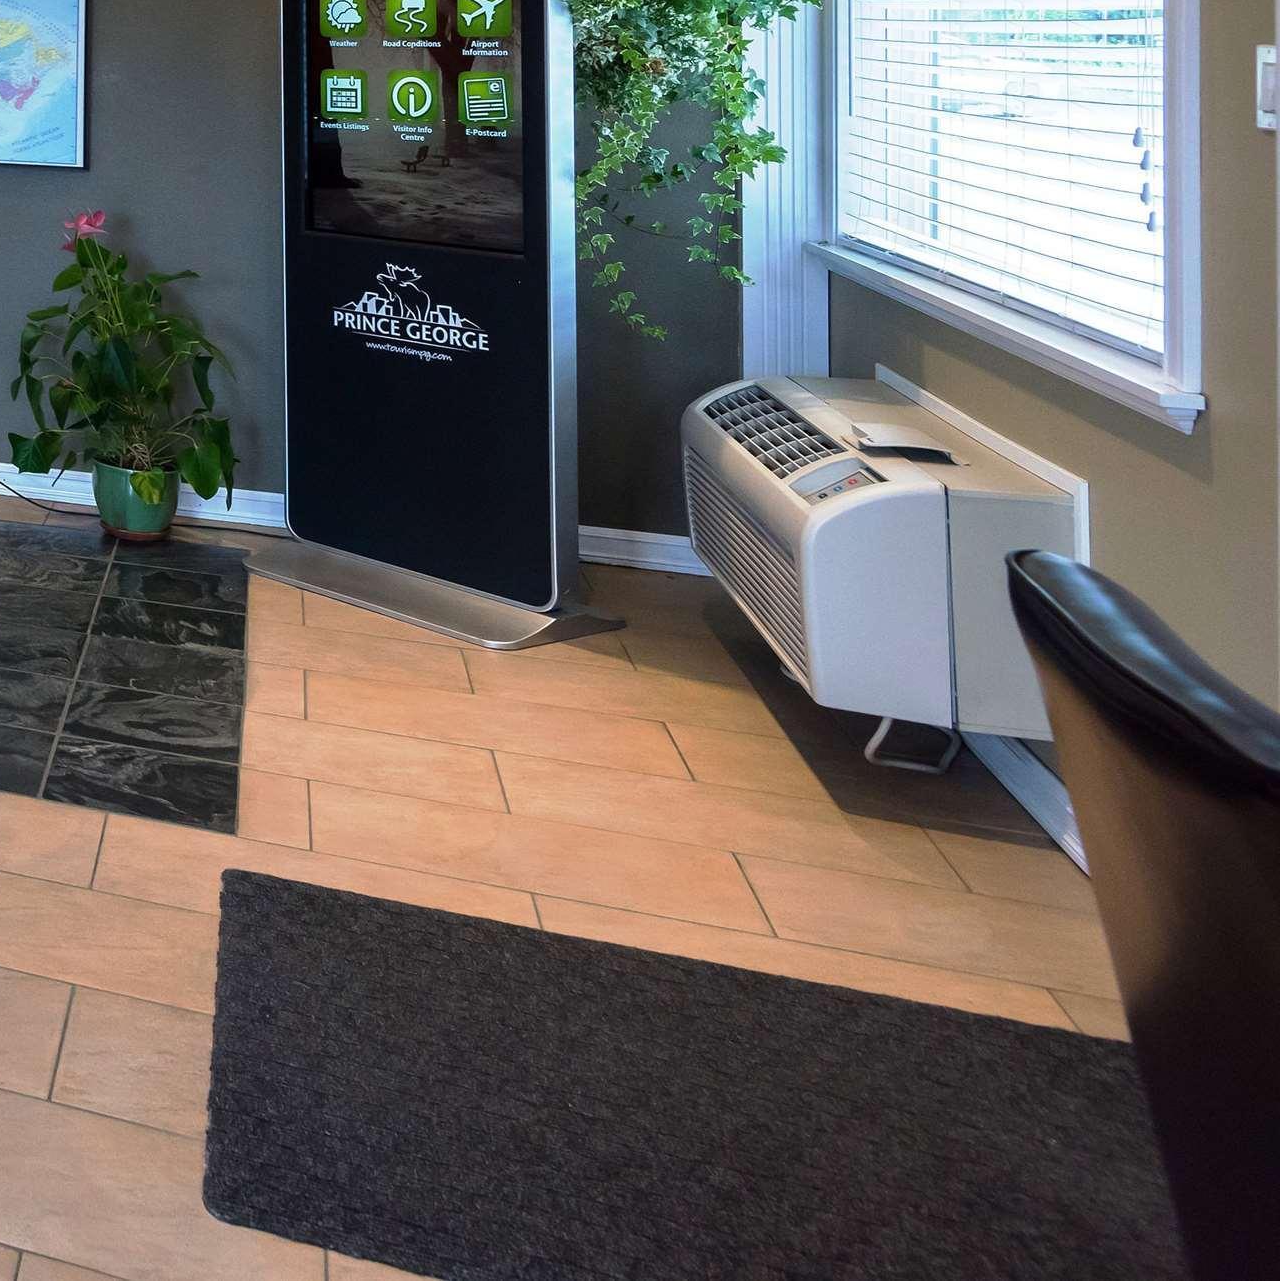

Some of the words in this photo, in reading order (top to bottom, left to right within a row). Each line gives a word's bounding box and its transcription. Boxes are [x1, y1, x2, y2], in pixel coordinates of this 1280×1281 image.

[471, 40, 498, 49] Airport
[343, 123, 369, 131] Listings
[393, 125, 417, 133] Visitor
[418, 126, 433, 134] Info
[400, 133, 425, 141] Centre
[466, 129, 507, 137] E-Postcard
[333, 310, 401, 337] PRINCE
[405, 322, 490, 351] GEORGE
